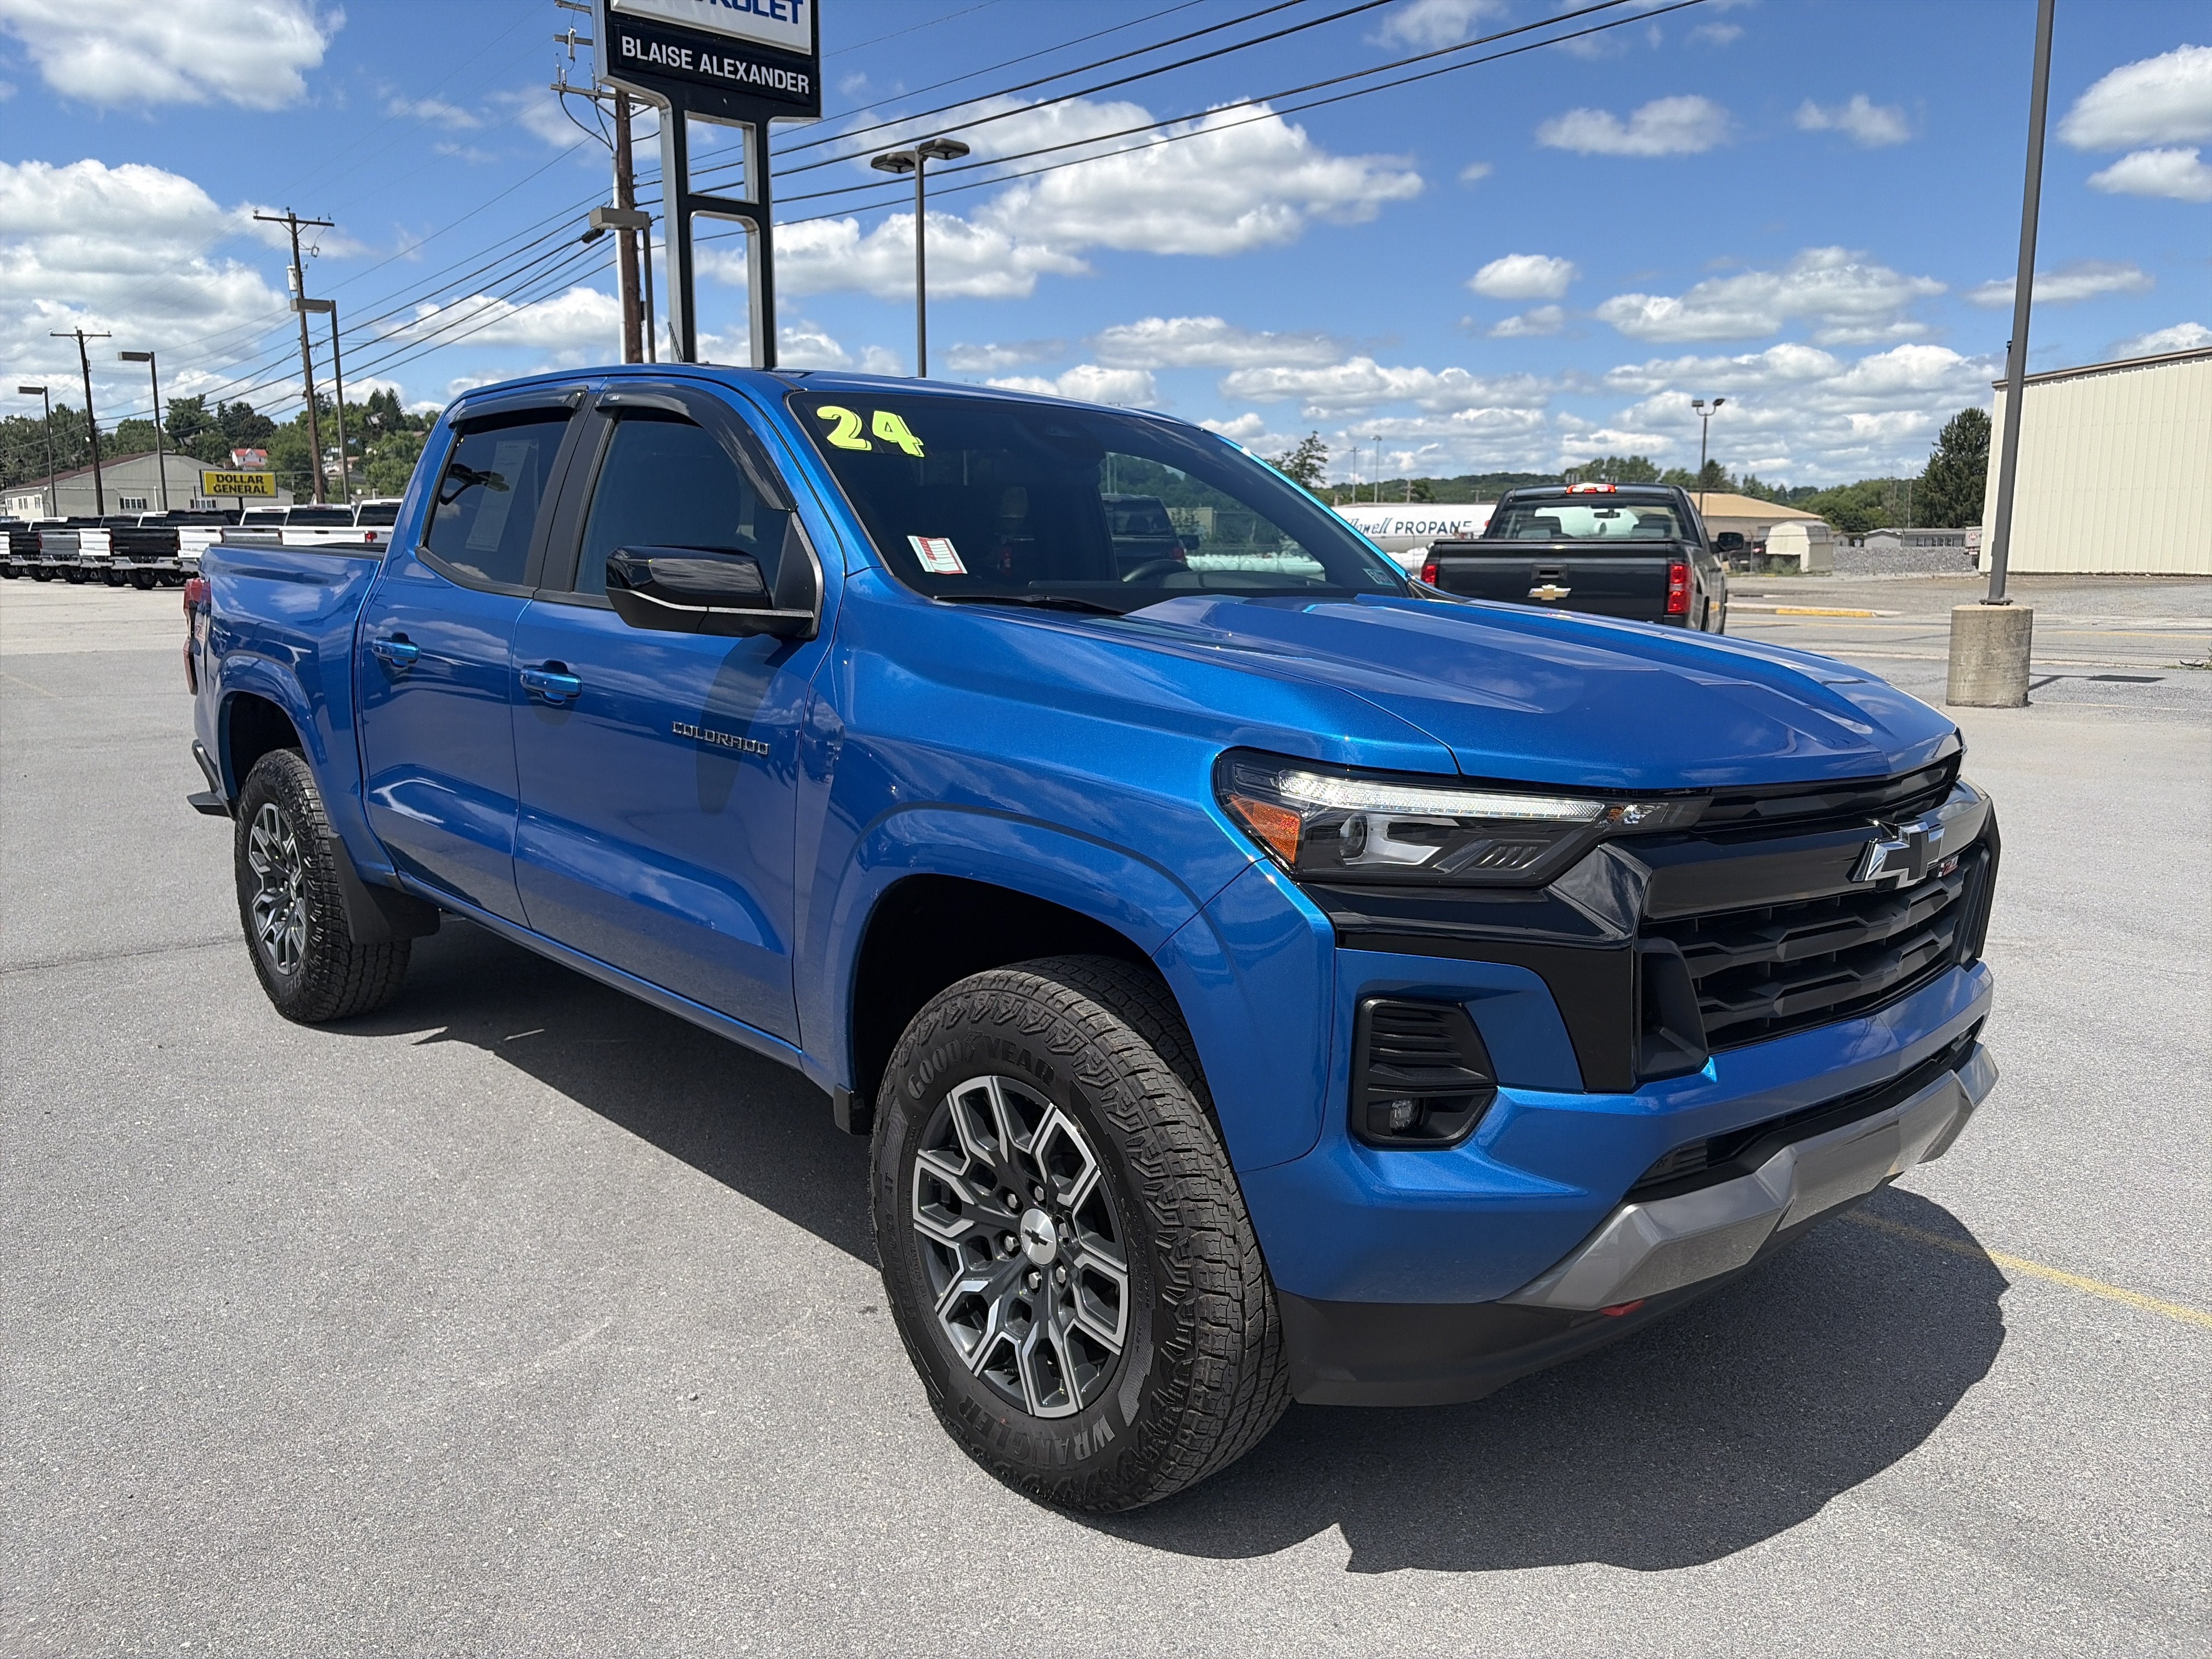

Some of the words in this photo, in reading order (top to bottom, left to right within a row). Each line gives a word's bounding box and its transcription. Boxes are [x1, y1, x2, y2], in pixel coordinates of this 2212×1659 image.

[622, 36, 693, 70] BLAISE
[699, 53, 809, 94] ALEXANDER
[817, 405, 925, 458] 24
[213, 484, 268, 494] GENERAL
[216, 474, 264, 484] DOLLAR
[672, 720, 770, 755] COLORADO
